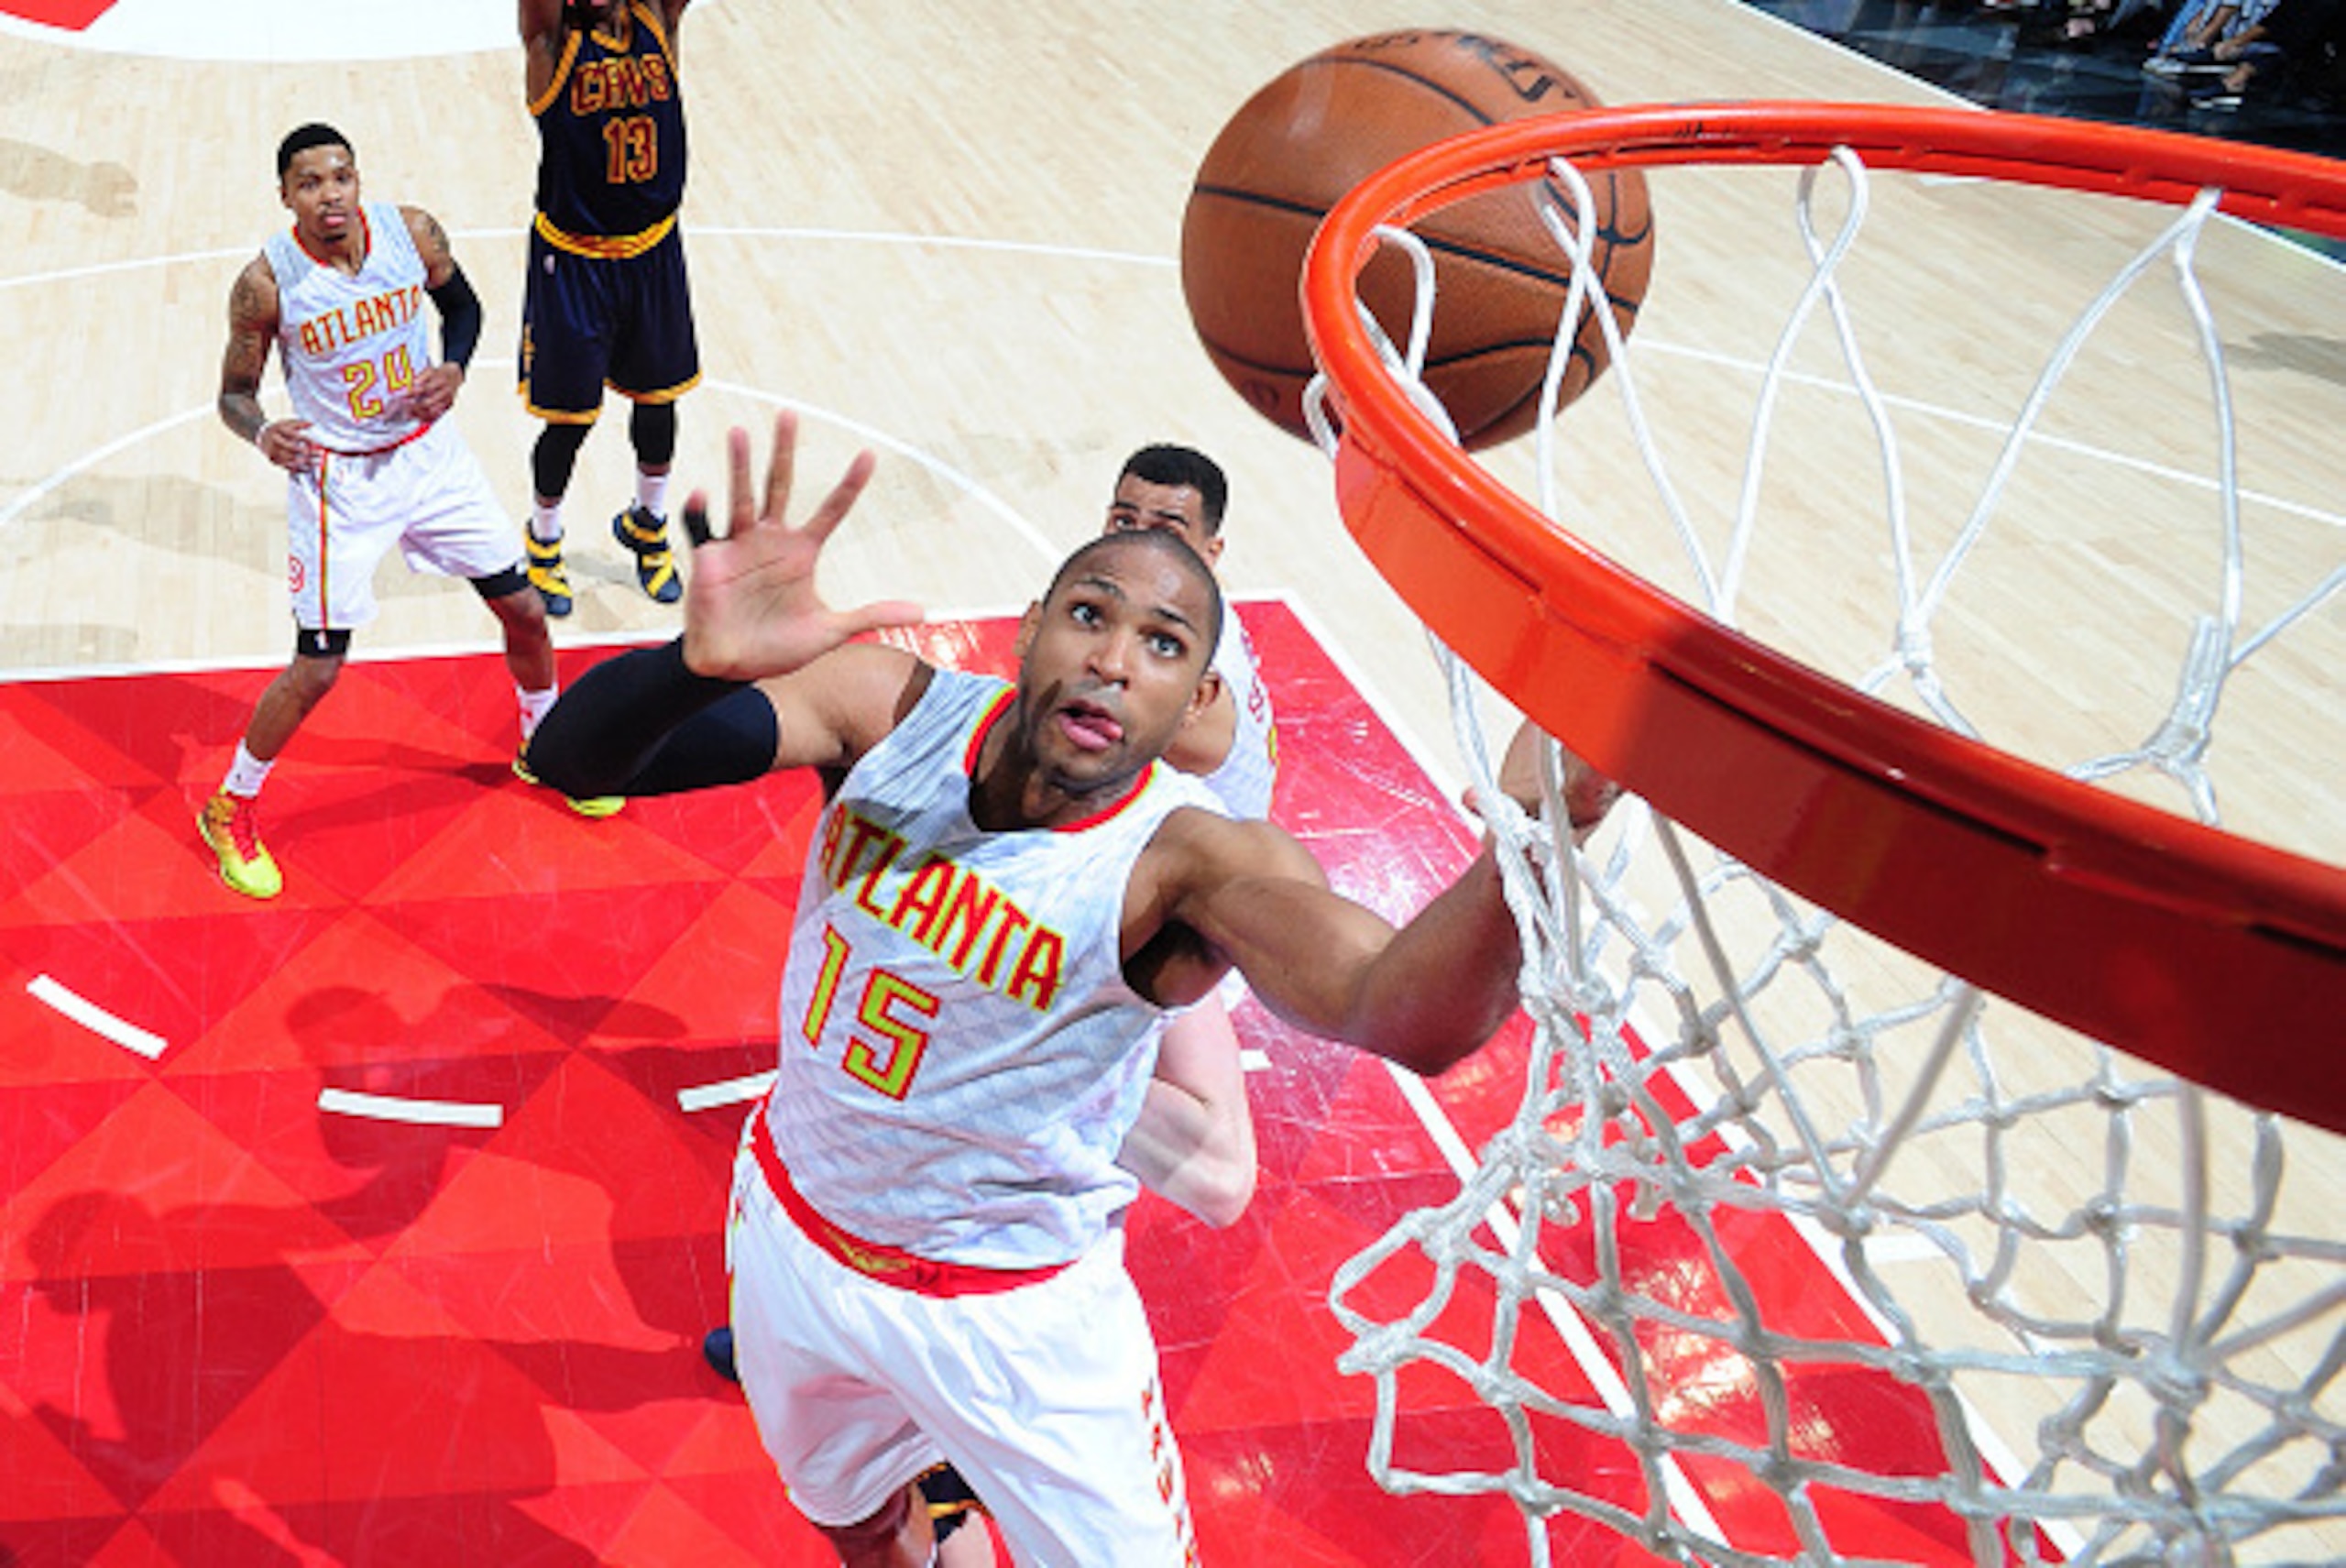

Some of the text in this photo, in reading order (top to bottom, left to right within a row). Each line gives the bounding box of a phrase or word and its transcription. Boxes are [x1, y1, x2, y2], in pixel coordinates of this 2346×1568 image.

[602, 116, 658, 183] 13
[818, 802, 1067, 1014] ATLANTA
[802, 920, 941, 1102] 15
